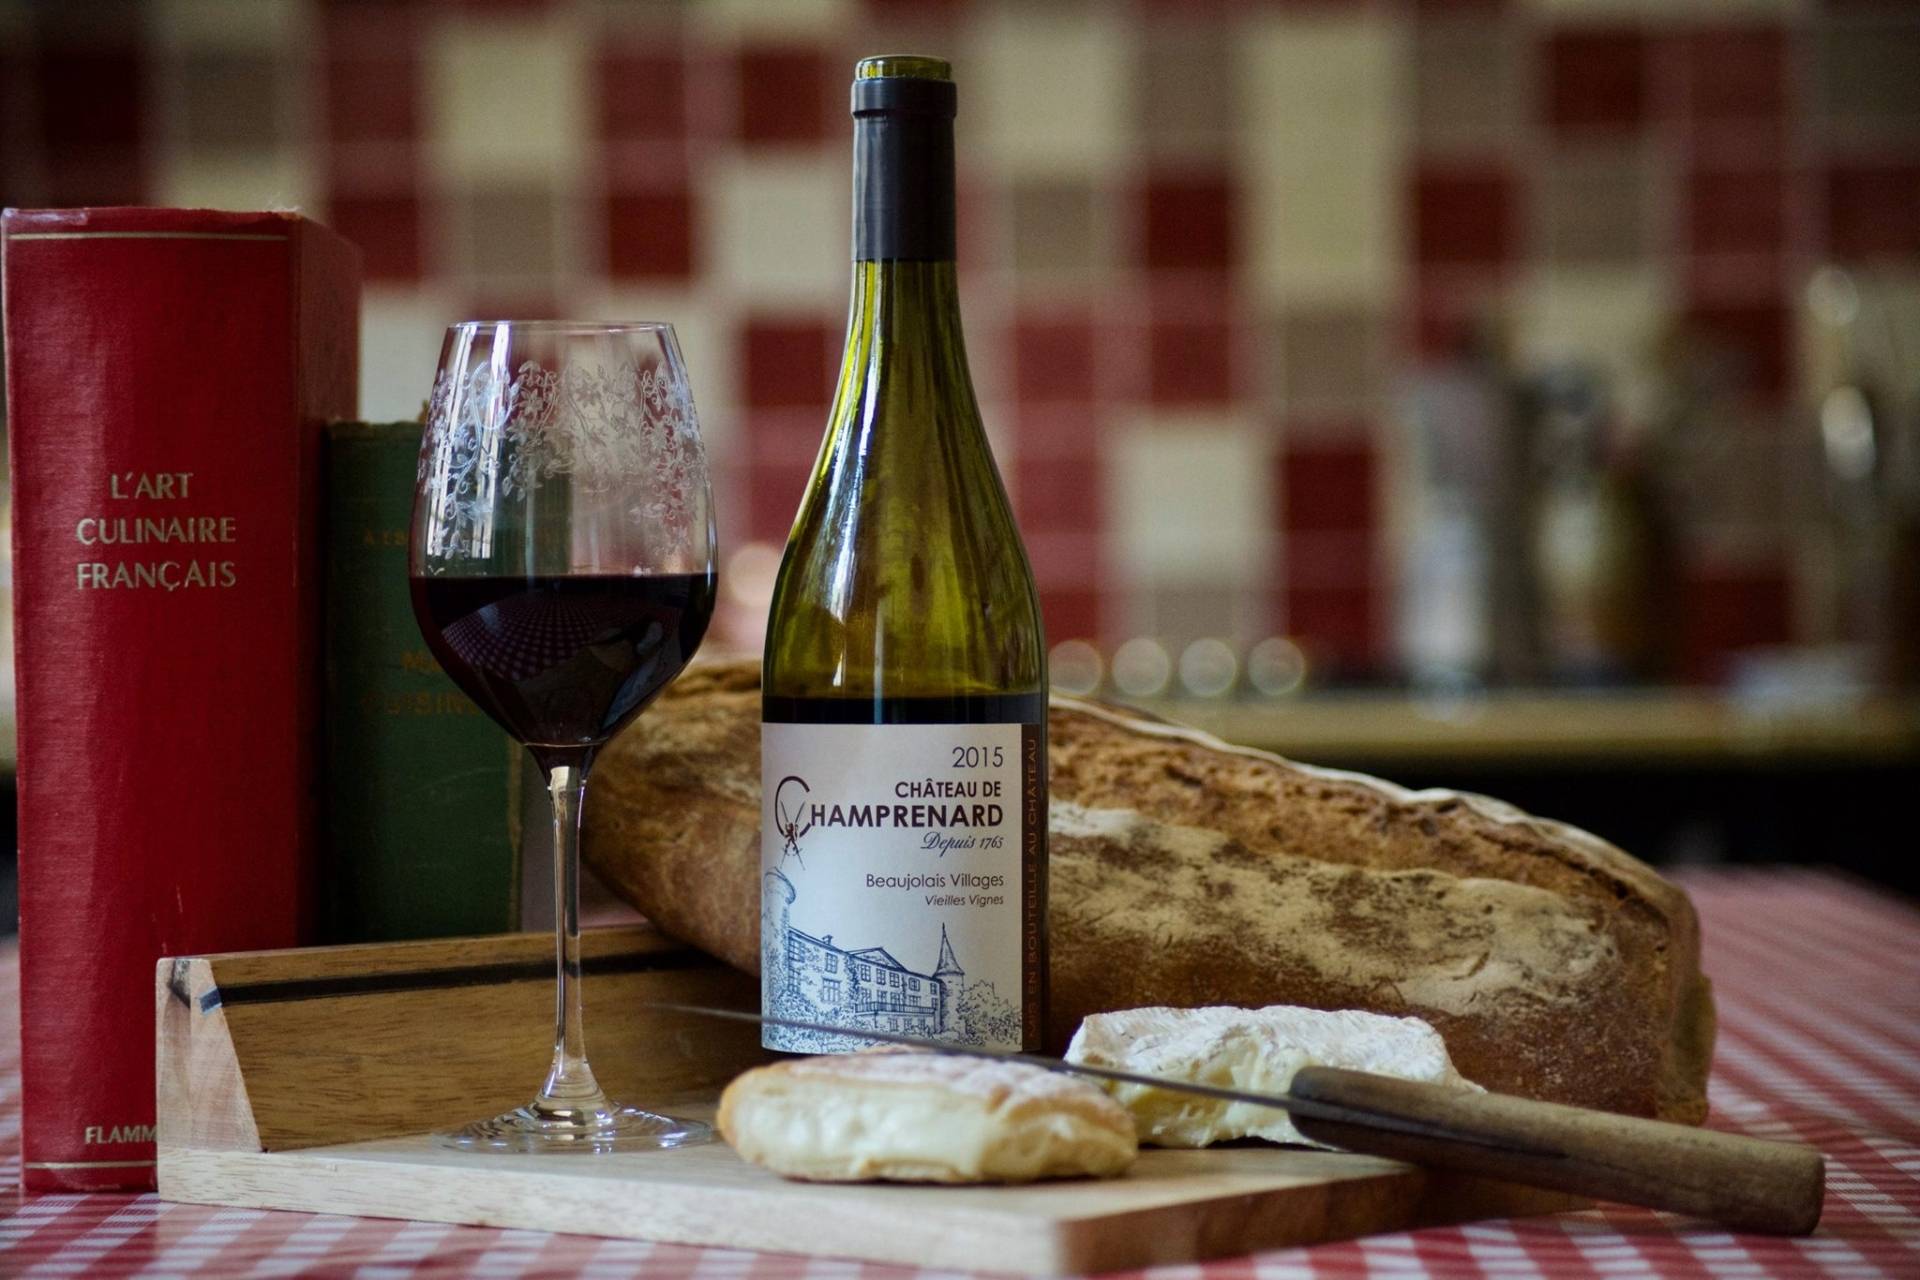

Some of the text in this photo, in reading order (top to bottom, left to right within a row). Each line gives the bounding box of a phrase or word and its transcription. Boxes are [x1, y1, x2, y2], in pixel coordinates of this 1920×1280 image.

[110, 472, 194, 500] L'ART
[75, 516, 237, 546] CULINAIRE
[75, 559, 237, 592] FRANÇAIS
[951, 746, 1004, 768] 2015
[895, 778, 1001, 799] CHÂTEAU DE
[1027, 739, 1037, 826] CHÂTEAU
[920, 831, 1004, 858] Depuis 1765
[1027, 832, 1037, 856] AU
[866, 873, 1004, 891] Beaujolais Villages
[925, 895, 1004, 908] Vieilles Vignes
[1027, 863, 1037, 963] BOUTEILLE
[1027, 971, 1037, 994] EN
